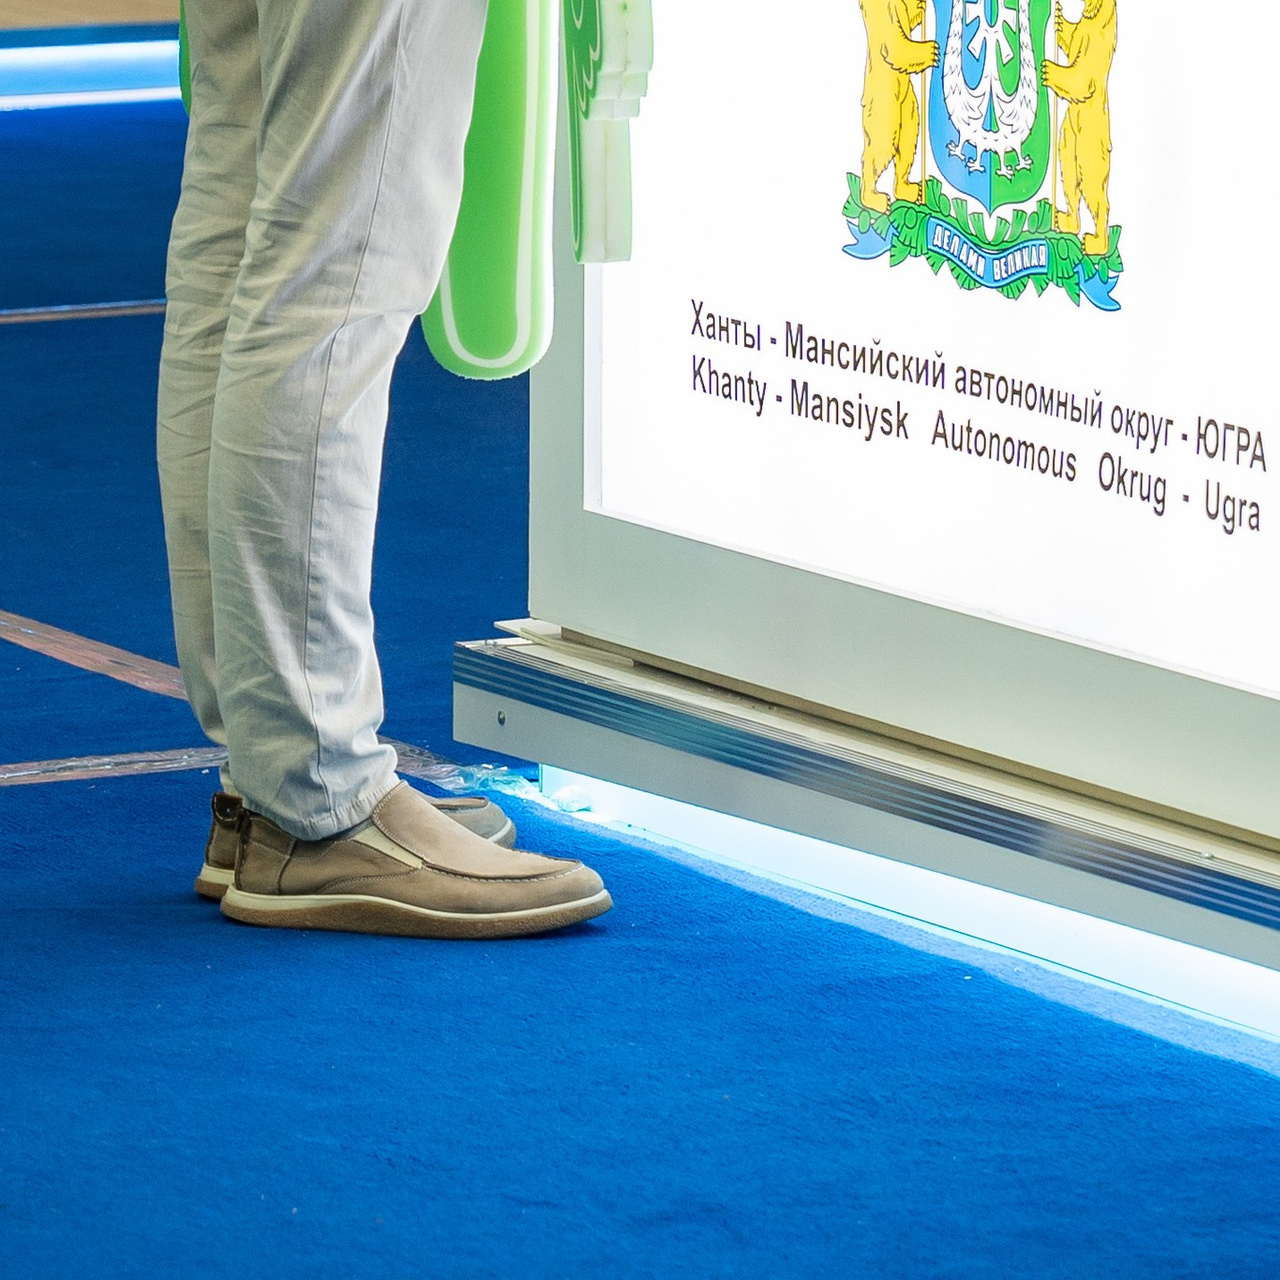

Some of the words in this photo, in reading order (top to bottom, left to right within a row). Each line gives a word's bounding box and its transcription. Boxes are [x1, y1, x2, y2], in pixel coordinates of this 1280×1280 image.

[933, 224, 986, 279] ДЕЛАМИ
[993, 243, 1047, 281] ВЕЛИКАЯ
[690, 298, 761, 351] Ханты
[785, 320, 946, 390] Мансийский
[954, 365, 1103, 429] автономный
[1110, 404, 1174, 454] округ
[1196, 415, 1267, 473] ЮГРА
[692, 354, 767, 418] Khanty
[790, 378, 909, 442] Mansiysk
[931, 409, 1077, 482] Autonomous
[1098, 451, 1167, 517] Okrug
[1205, 479, 1260, 536] Ugra
